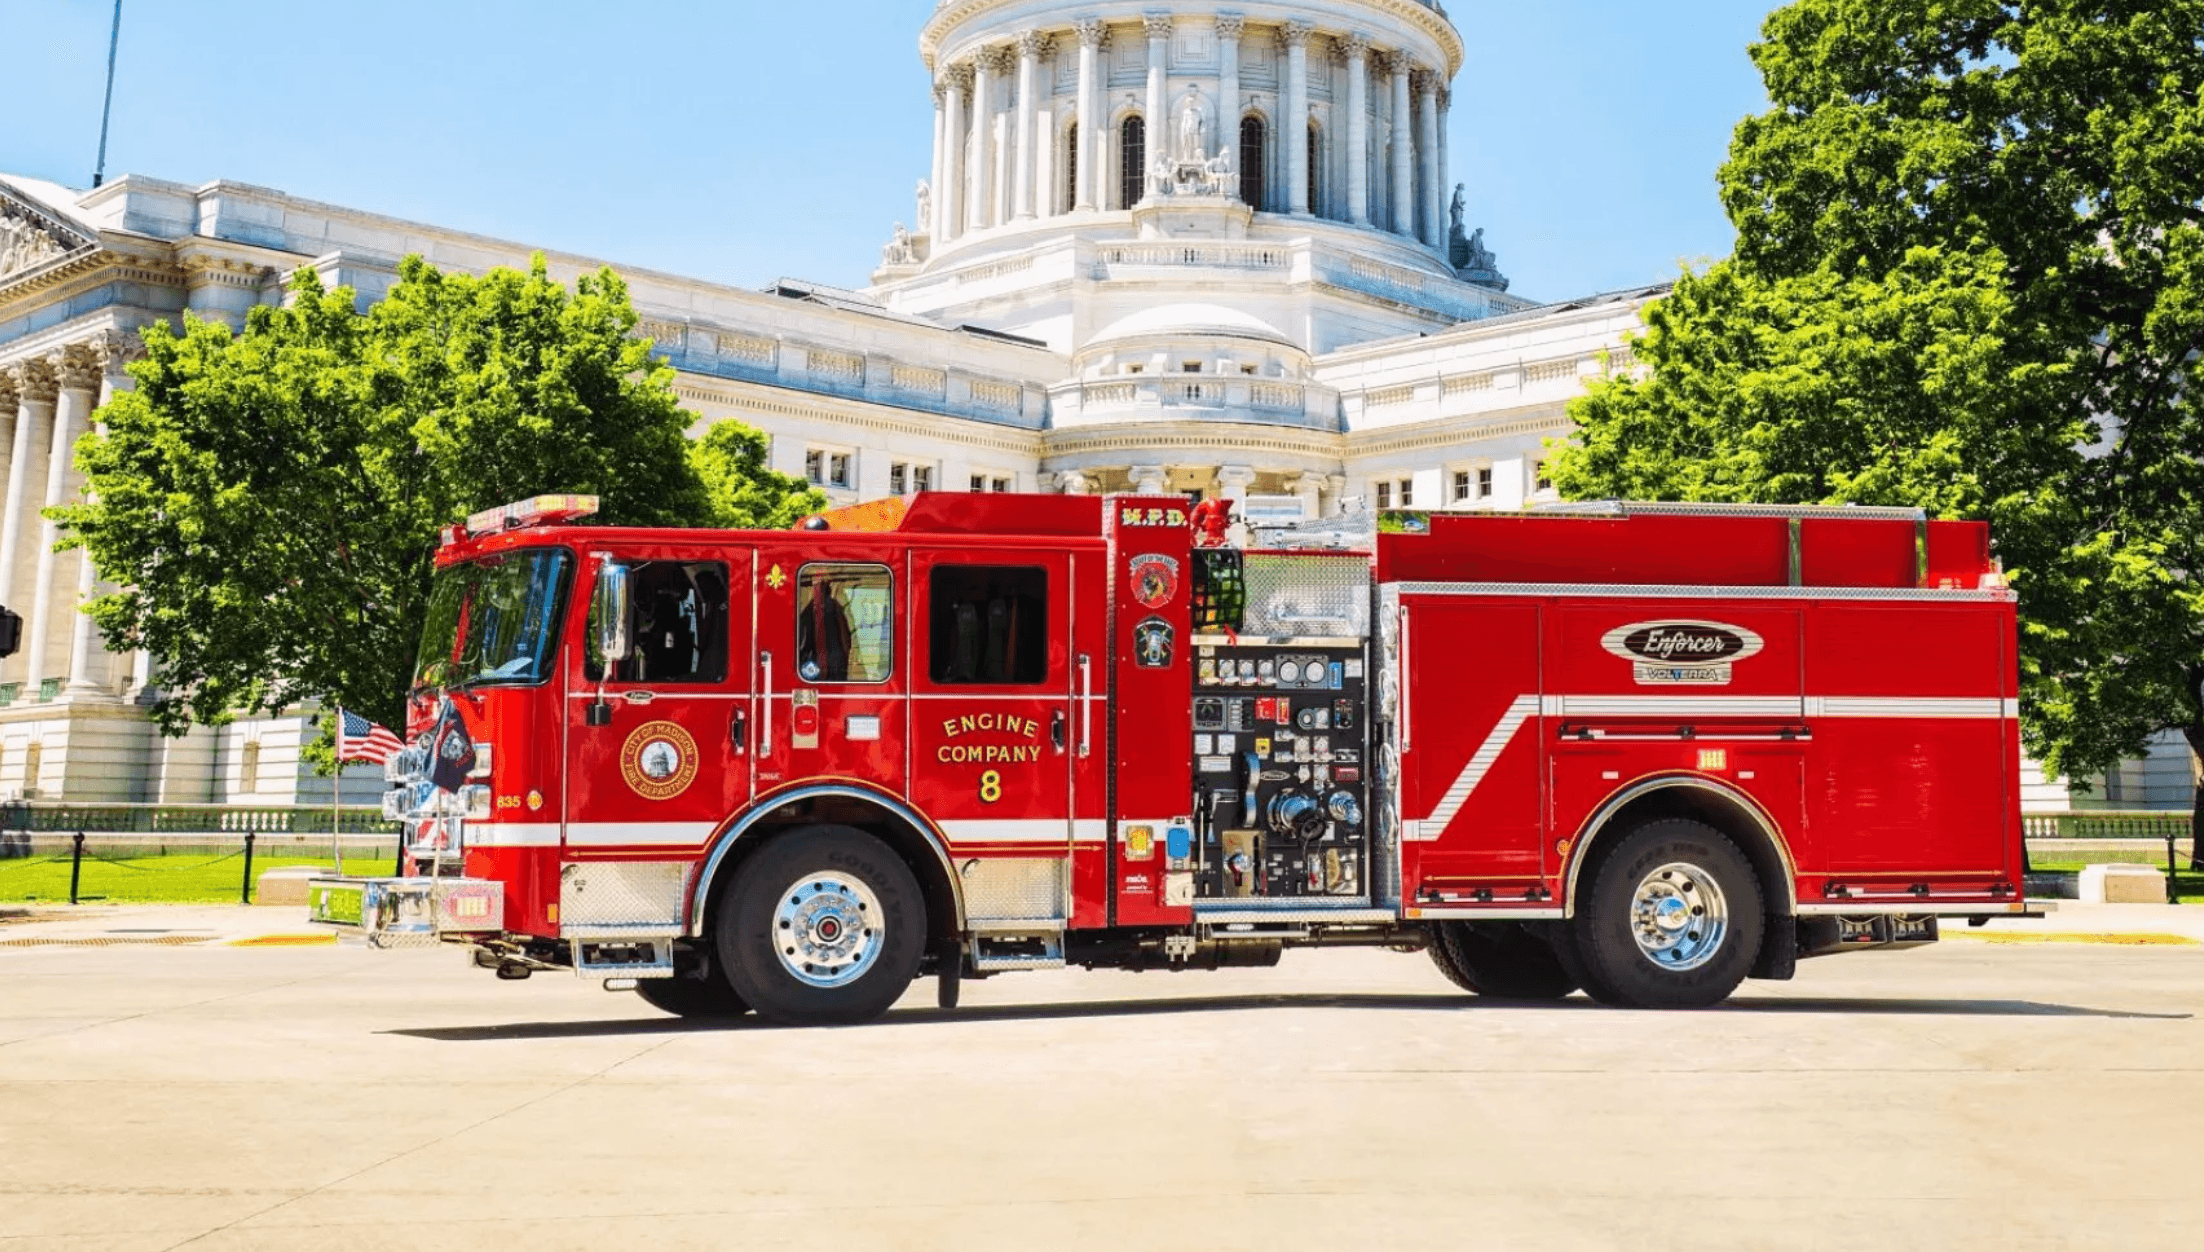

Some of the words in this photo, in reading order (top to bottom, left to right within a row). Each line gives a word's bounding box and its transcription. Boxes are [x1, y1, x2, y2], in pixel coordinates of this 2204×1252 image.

[1643, 629, 1725, 659] Enforcer
[1647, 668, 1718, 681] VOLTERRA
[626, 733, 642, 755] CITY
[641, 726, 655, 737] OF
[656, 725, 694, 755] MADISON
[943, 713, 1039, 738] ENGINE
[938, 745, 1041, 762] COMPANY
[625, 763, 641, 785] FIRE
[639, 764, 694, 796] DEPARTMENT
[981, 769, 1002, 802] 8
